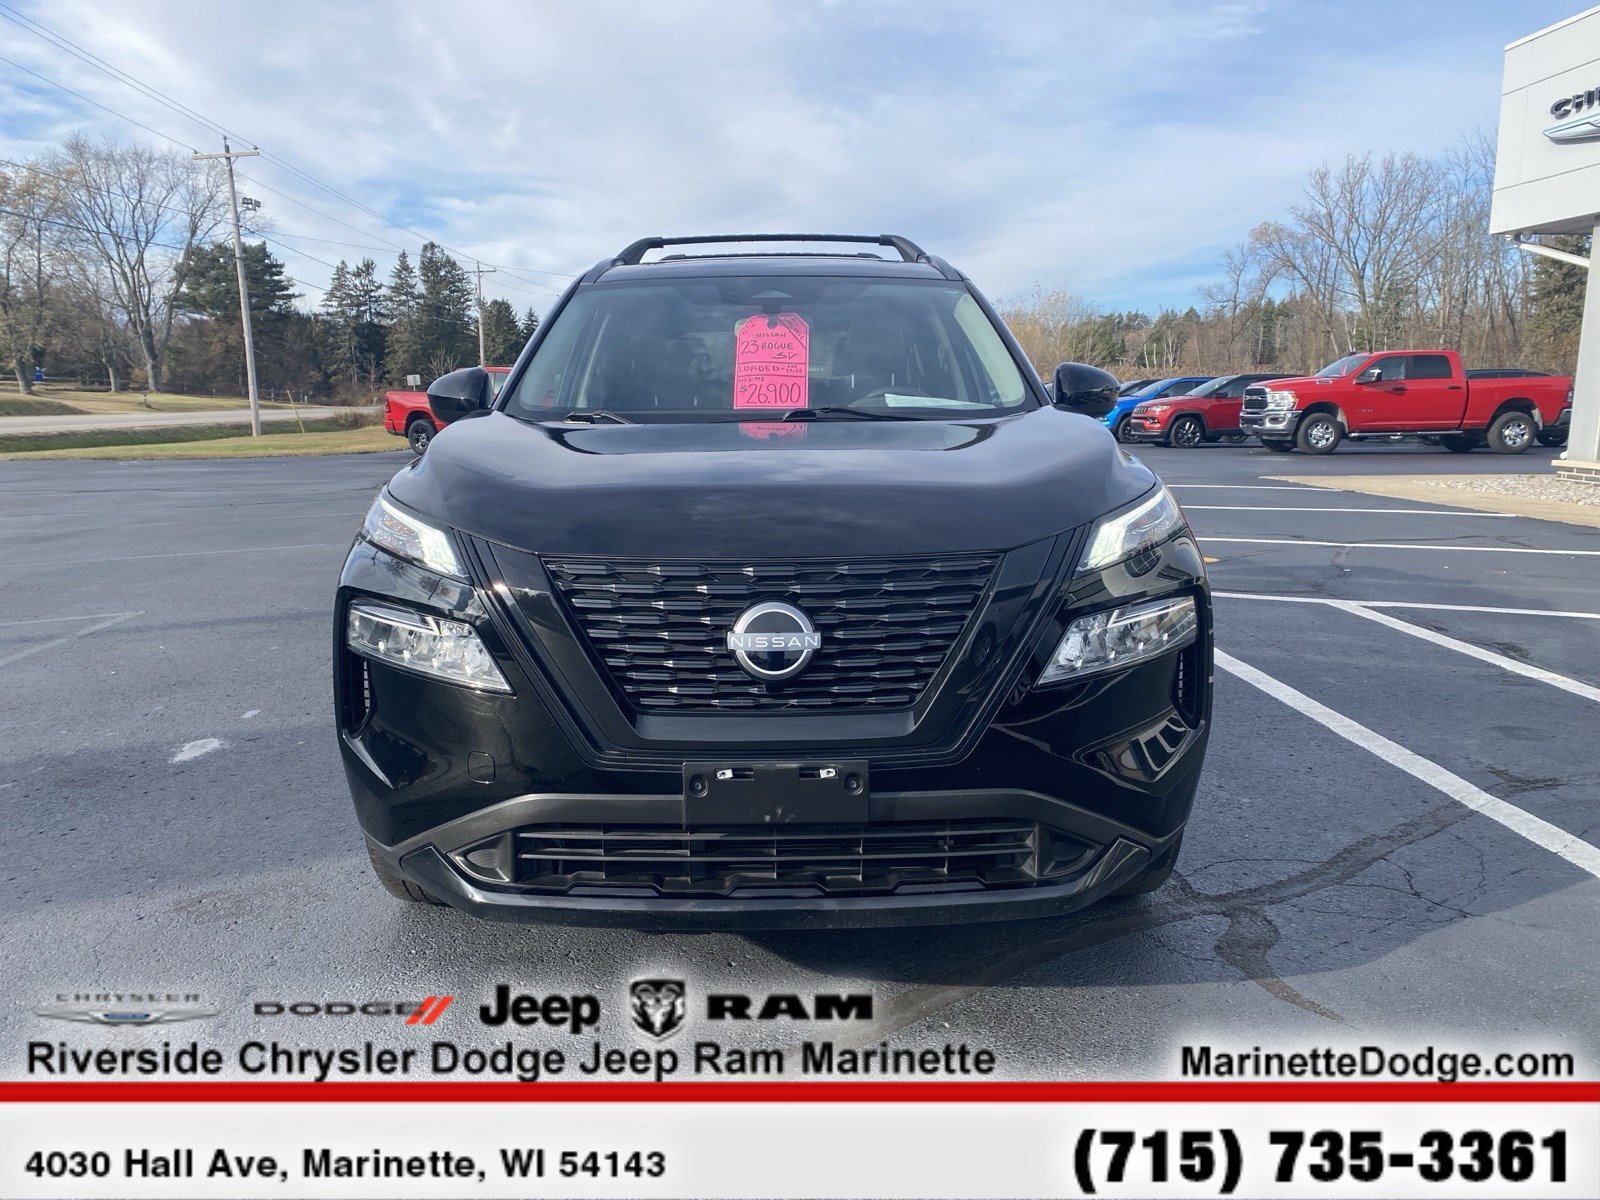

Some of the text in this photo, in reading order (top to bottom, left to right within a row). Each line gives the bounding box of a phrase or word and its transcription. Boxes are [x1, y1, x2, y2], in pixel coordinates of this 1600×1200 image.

[741, 340, 794, 355] 23 ROGUE
[730, 635, 818, 648] NISSAN
